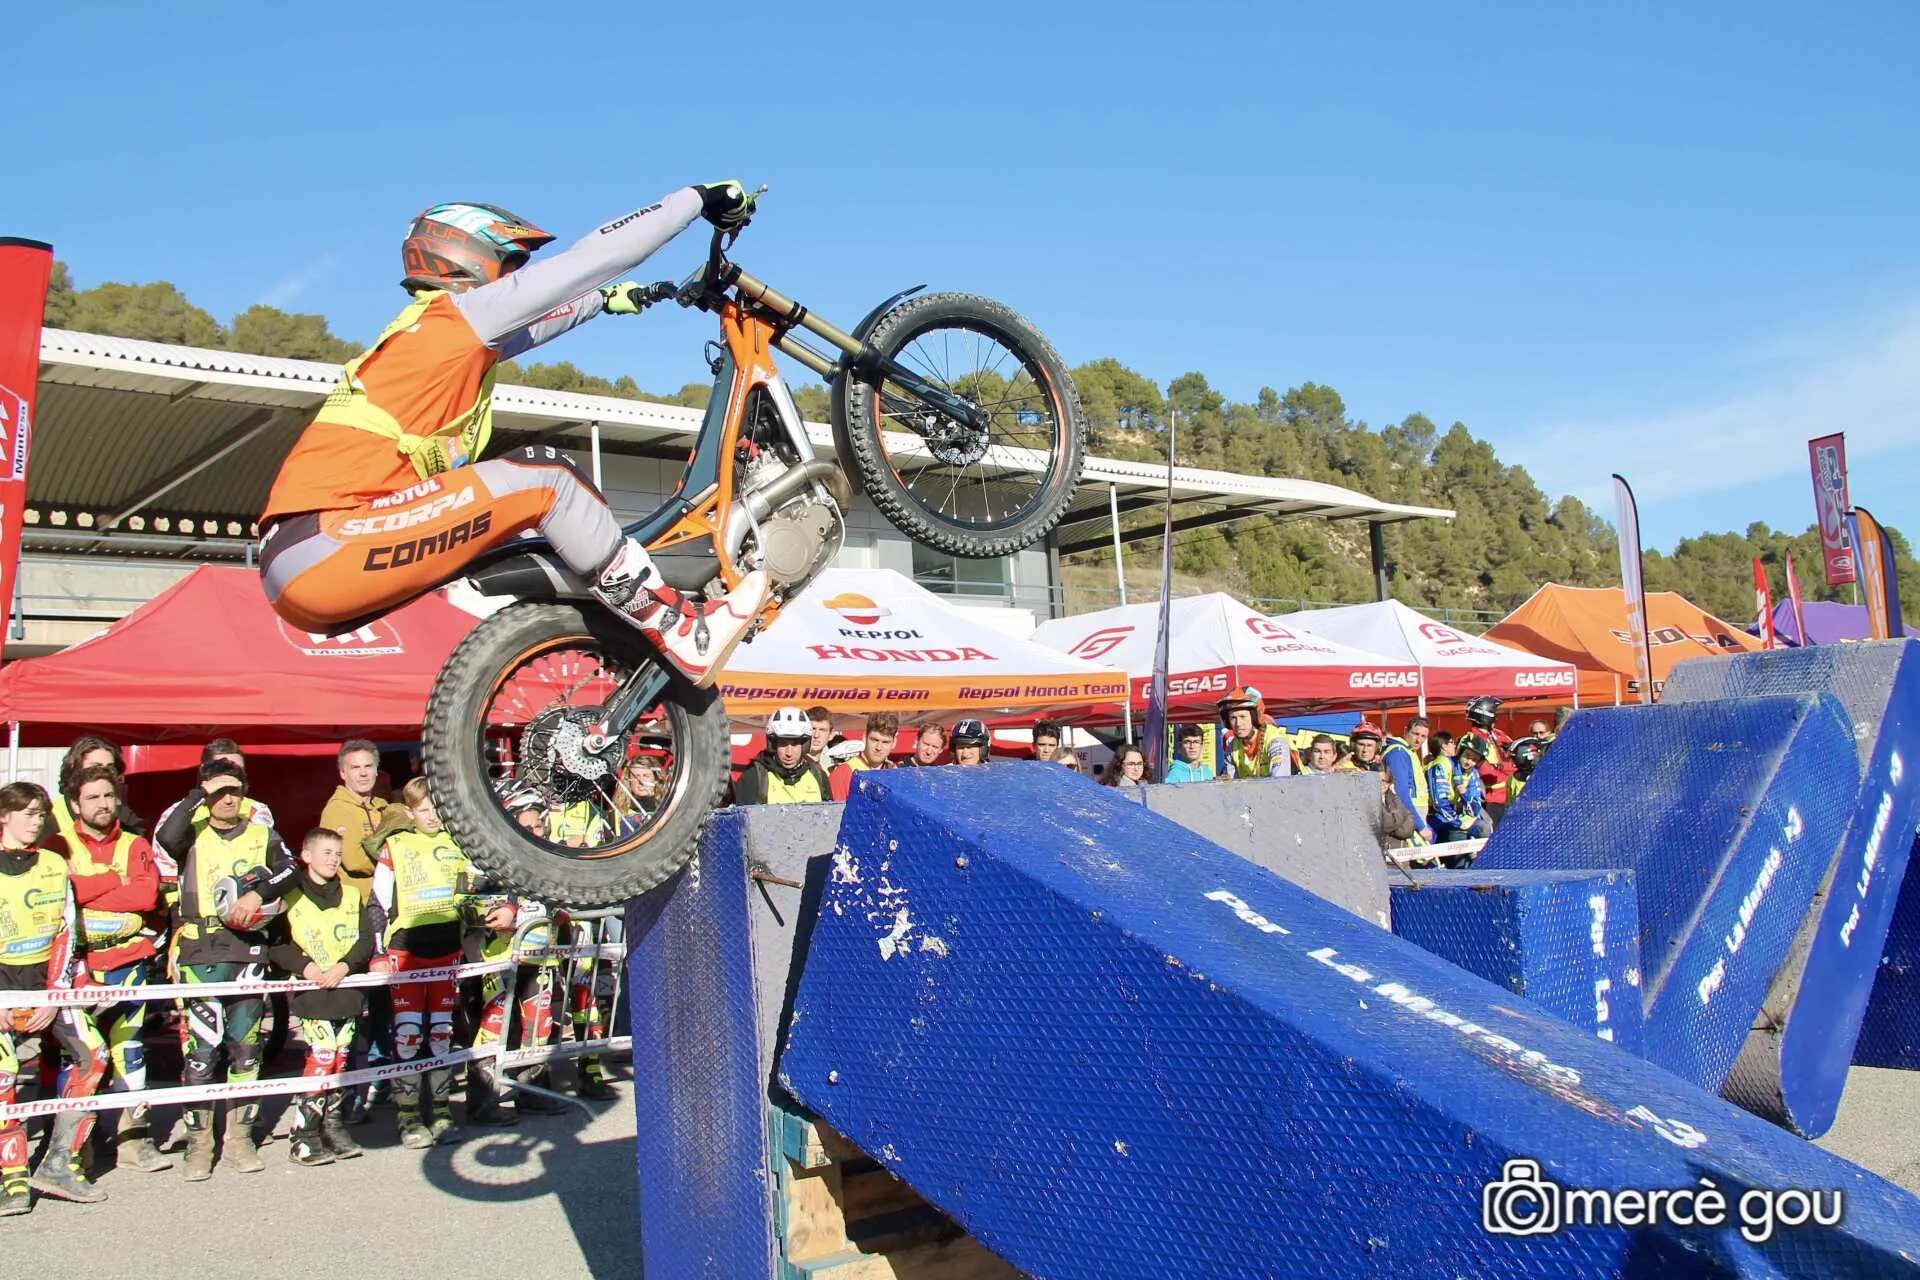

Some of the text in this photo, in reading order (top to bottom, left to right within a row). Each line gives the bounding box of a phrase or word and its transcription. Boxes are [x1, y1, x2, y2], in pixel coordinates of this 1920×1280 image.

[599, 203, 664, 235] COMAS
[15, 405, 27, 474] Montesa
[370, 479, 442, 509] MOTUL
[338, 486, 475, 536] SCORPA
[363, 511, 492, 571] COMAS
[838, 628, 924, 640] REPSOL
[806, 645, 999, 662] HONDA
[958, 681, 1126, 700] Repsol Honda Team
[1142, 674, 1228, 699] GSGAS
[1349, 672, 1419, 688] GASGAS
[1515, 672, 1574, 687] GASGAS
[720, 684, 930, 701] Repsol Honda Team
[1204, 889, 1291, 935] Per
[1306, 947, 1374, 982] La
